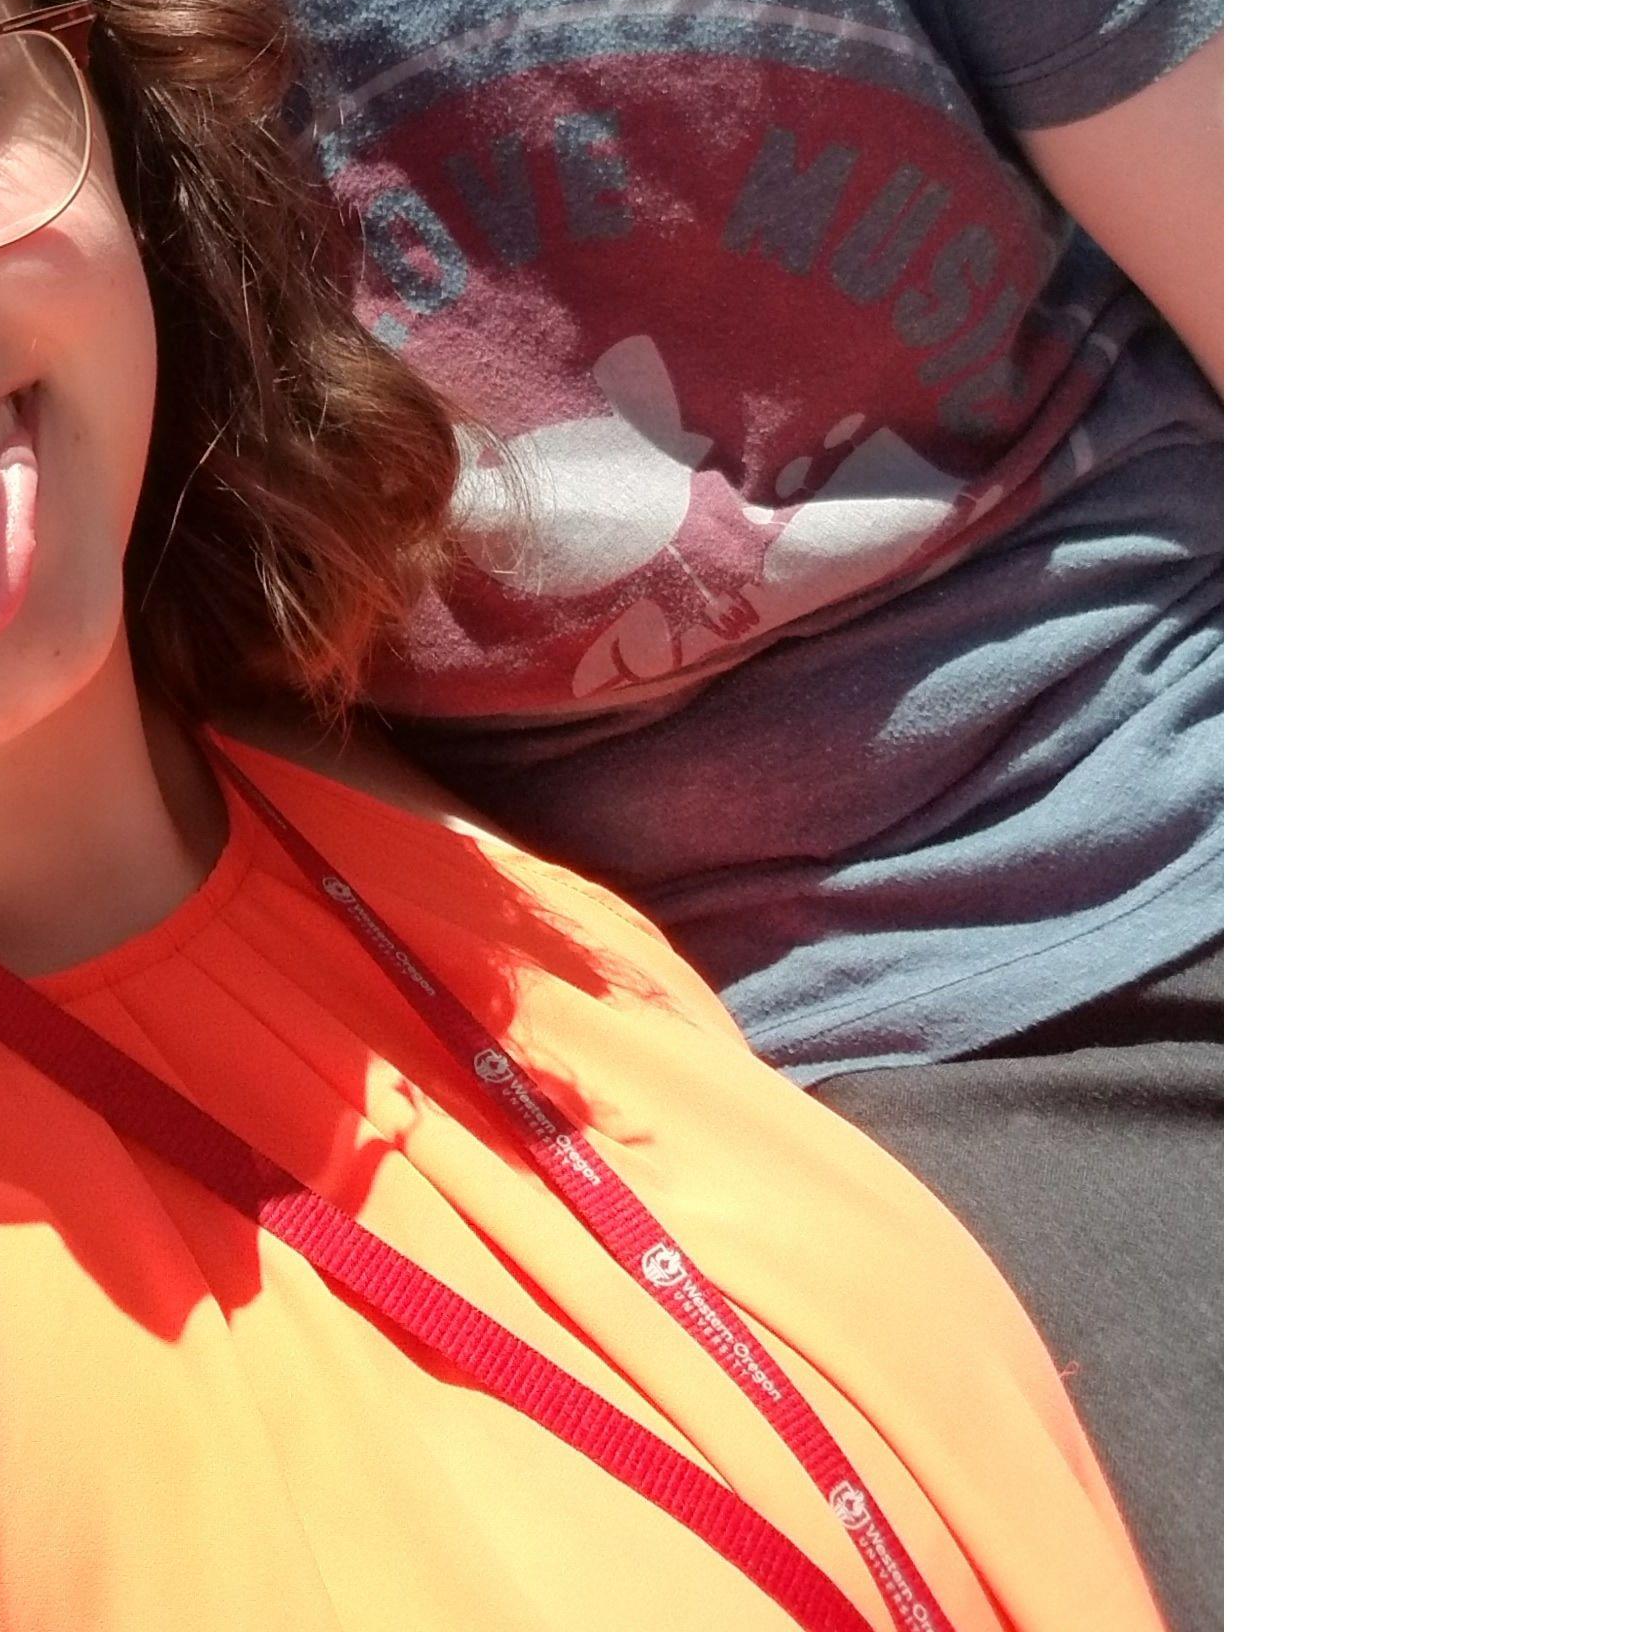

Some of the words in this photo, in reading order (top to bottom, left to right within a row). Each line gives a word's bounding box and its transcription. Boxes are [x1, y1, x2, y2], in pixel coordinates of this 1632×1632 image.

[363, 111, 634, 352] OVE
[723, 127, 1027, 439] MUSIC
[510, 1079, 556, 1134] Western
[556, 1134, 601, 1185] Oregon
[674, 1291, 749, 1377] UNIVERSITY
[682, 1279, 734, 1343] Western
[733, 1342, 783, 1402] Oregon
[866, 1523, 913, 1601] Western
